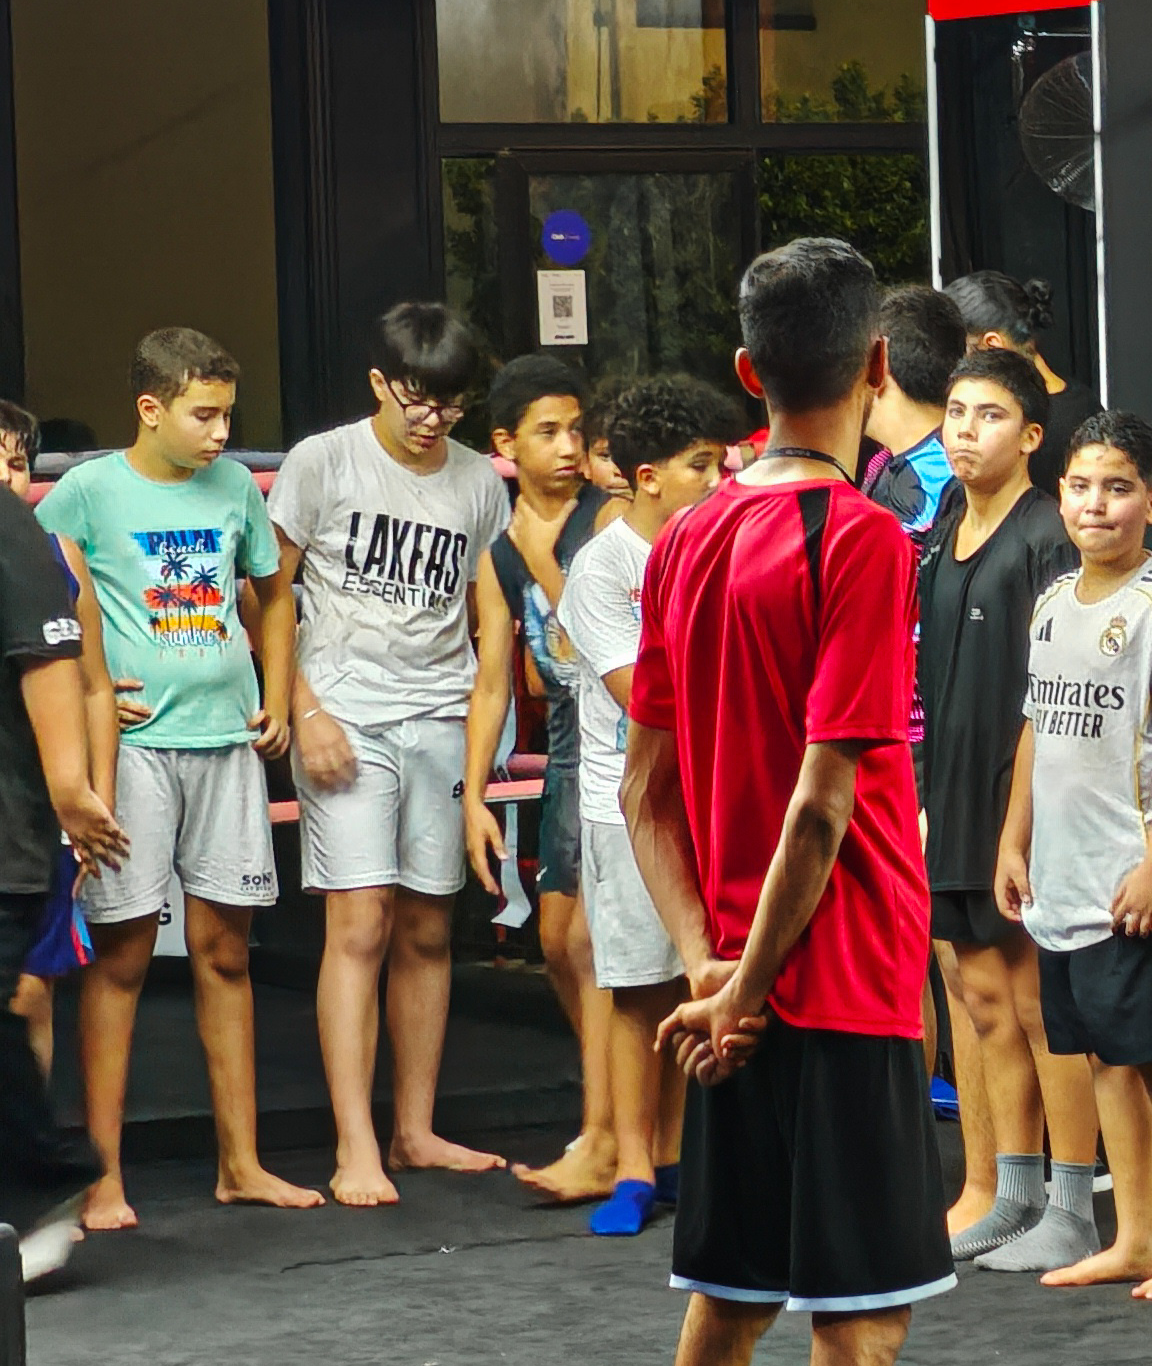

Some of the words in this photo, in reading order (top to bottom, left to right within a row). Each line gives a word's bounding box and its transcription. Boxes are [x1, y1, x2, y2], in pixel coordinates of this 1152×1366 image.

[345, 511, 468, 595] LAKERS
[1028, 673, 1126, 710] Emirates
[1048, 710, 1104, 739] BETTER
